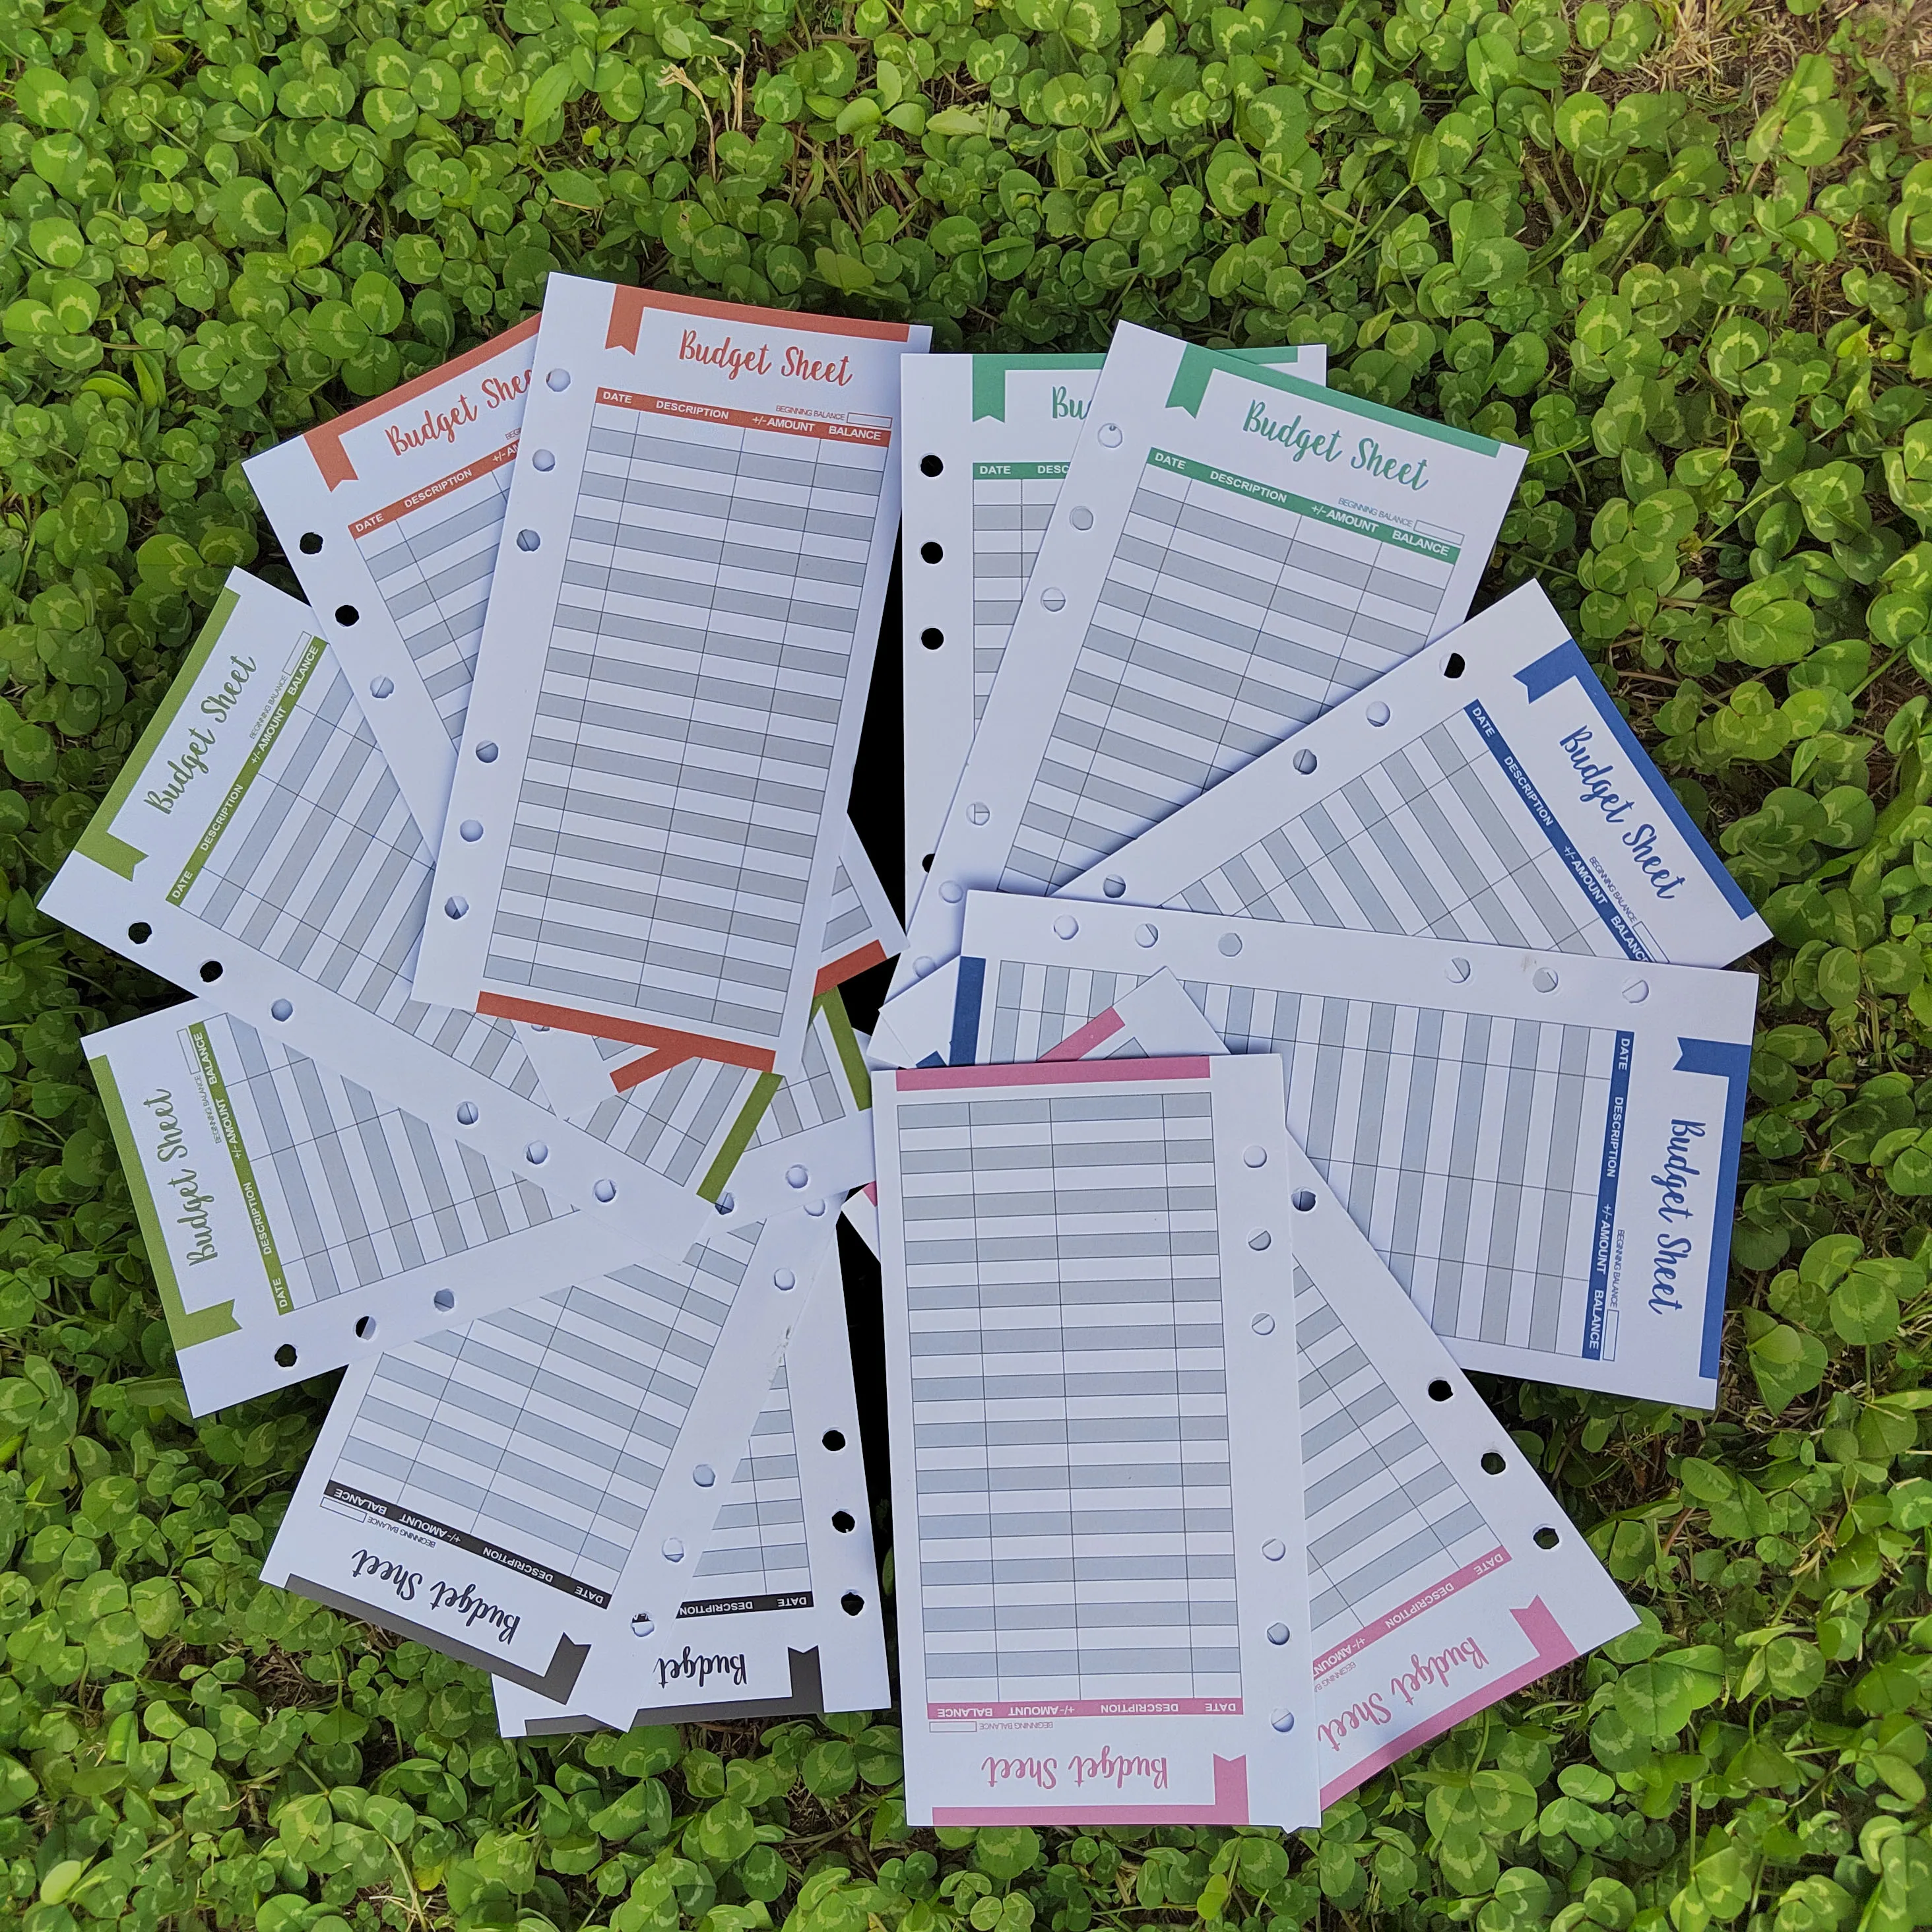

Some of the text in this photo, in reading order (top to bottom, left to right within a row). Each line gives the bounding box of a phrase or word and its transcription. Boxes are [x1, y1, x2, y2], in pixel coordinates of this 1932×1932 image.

[679, 329, 853, 387] Budget Sheet
[385, 395, 477, 456] Budget
[602, 391, 632, 404] DATE
[656, 401, 729, 420] DESCRIPTION
[829, 426, 882, 441] BALANCE
[979, 465, 1011, 474] DATE
[1242, 399, 1429, 491] Budget Sheet
[355, 513, 384, 532] DATE
[404, 468, 472, 509] DESCRIPTION
[1154, 452, 1187, 470] DATE
[1209, 470, 1287, 503] DESCRIPTION
[1392, 530, 1450, 556] BALANCE
[143, 655, 257, 815] Budget Sheet
[172, 870, 193, 899] DATE
[201, 784, 243, 851] DESCRIPTION
[288, 645, 319, 696] BALANCE
[1472, 707, 1496, 738] DATE
[1504, 756, 1553, 826] DESCRIPTION
[1559, 724, 1686, 899] Budget Sheet
[195, 1033, 217, 1085] BALANCE
[1619, 1038, 1630, 1071] DATE
[1607, 1097, 1624, 1178] DESCRIPTION
[143, 1088, 218, 1266] Budget Sheet
[243, 1182, 272, 1255] DESCRIPTION
[1648, 1119, 1706, 1314] Budget Sheet
[273, 1277, 288, 1308] DATE
[1589, 1289, 1604, 1349] BALANCE
[335, 1488, 388, 1515] BALANCE
[482, 1546, 554, 1584] DESCRIPTION
[1473, 1553, 1503, 1576] DATE
[351, 1549, 521, 1646] Budget Sheet
[573, 1585, 604, 1605] DATE
[679, 1596, 808, 1616] DATE DESCRIPTION
[1385, 1583, 1454, 1628] DESCRIPTION
[653, 1646, 748, 1689] Budget
[1318, 1636, 1489, 1751] Budget Sheet
[937, 1708, 993, 1717] BALANCE
[1101, 1702, 1178, 1713] DESCRIPTION
[1205, 1702, 1237, 1712] DATE
[981, 1745, 1168, 1789] Budget Sheet
